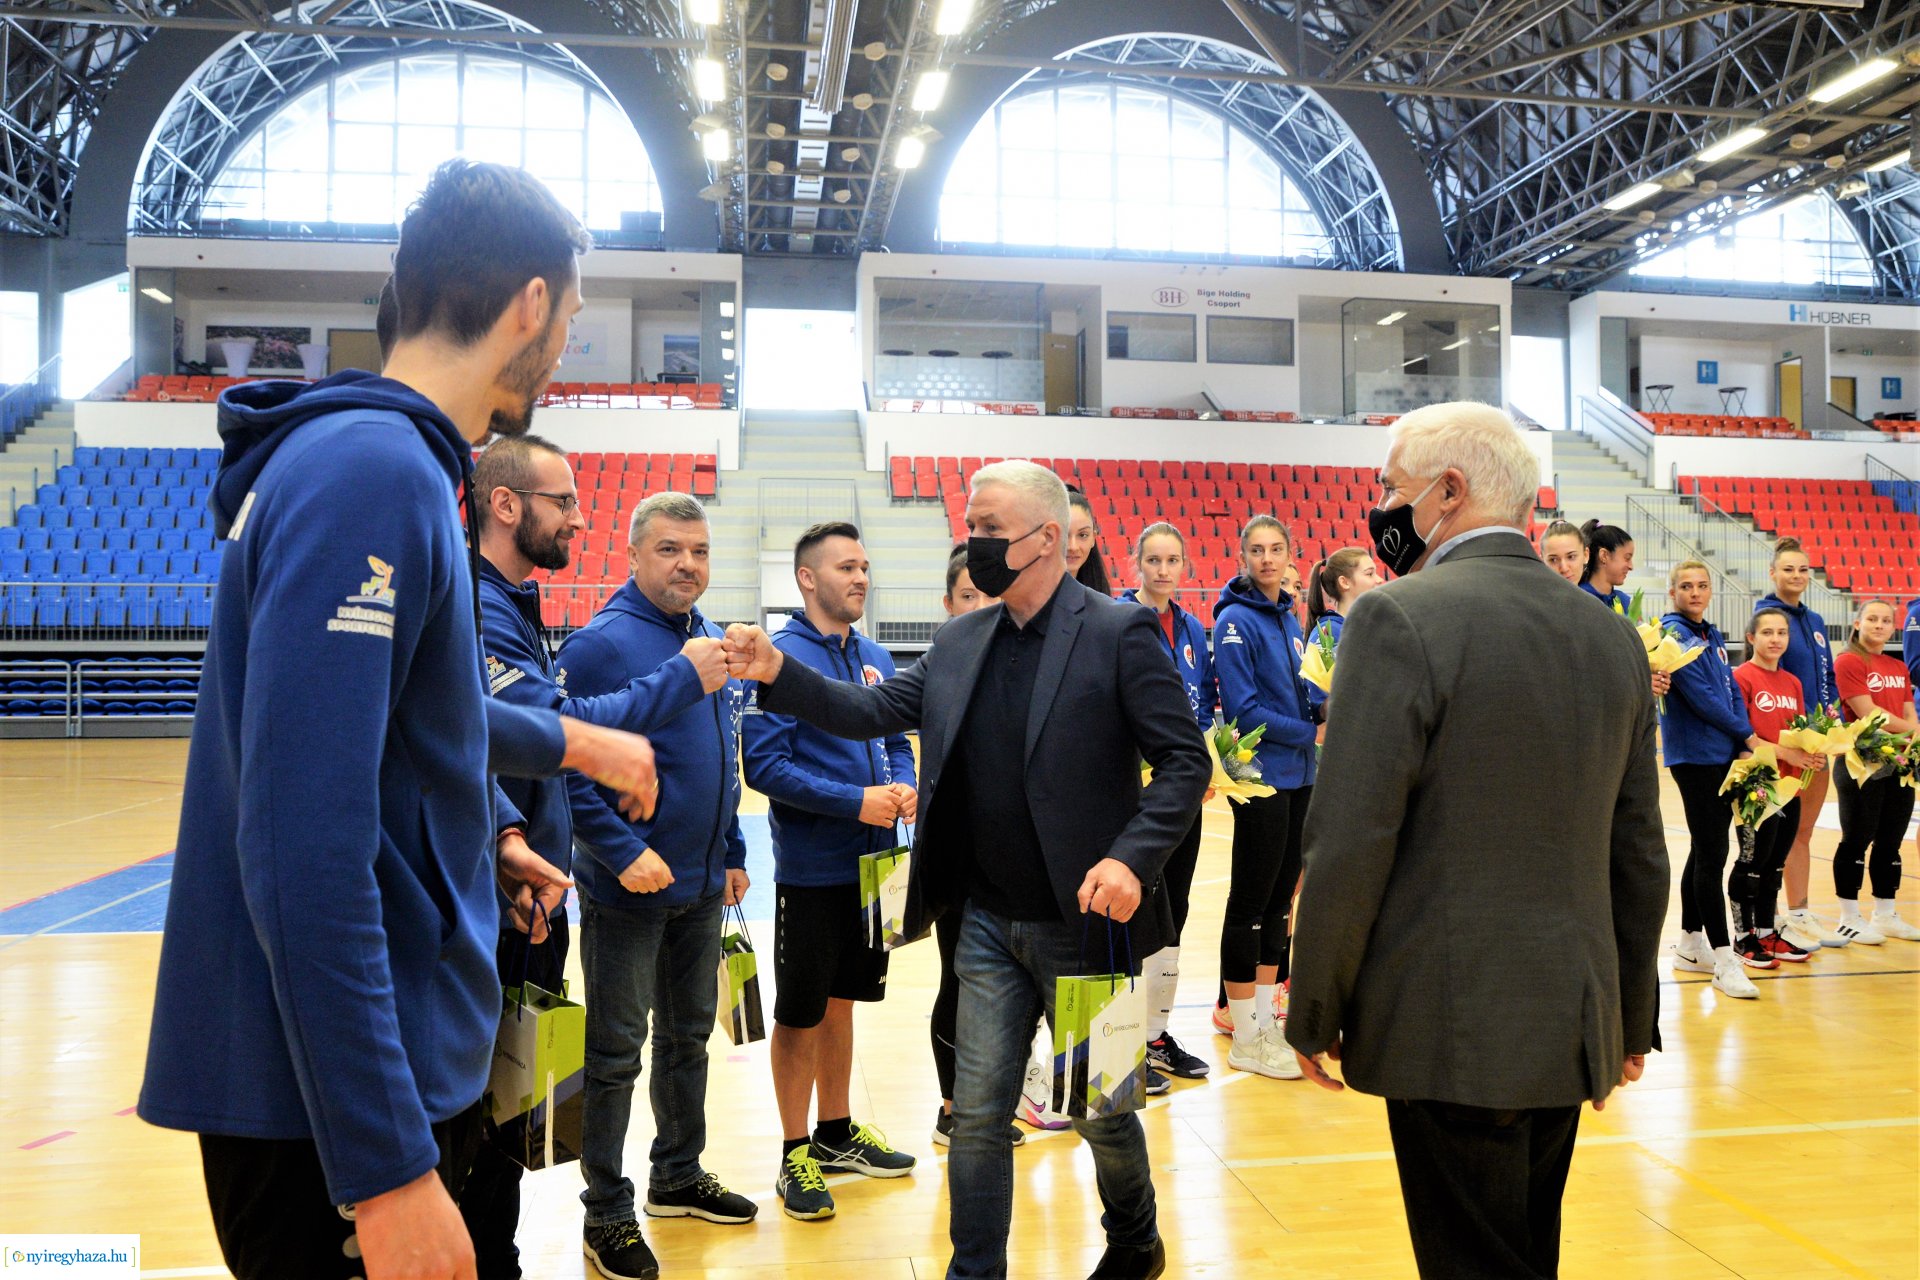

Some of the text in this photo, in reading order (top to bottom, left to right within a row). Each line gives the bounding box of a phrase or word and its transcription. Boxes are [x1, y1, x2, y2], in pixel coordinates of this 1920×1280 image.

[1160, 290, 1182, 304] BH
[1197, 289, 1251, 299] Bige Holding
[1207, 300, 1240, 308] Csoport
